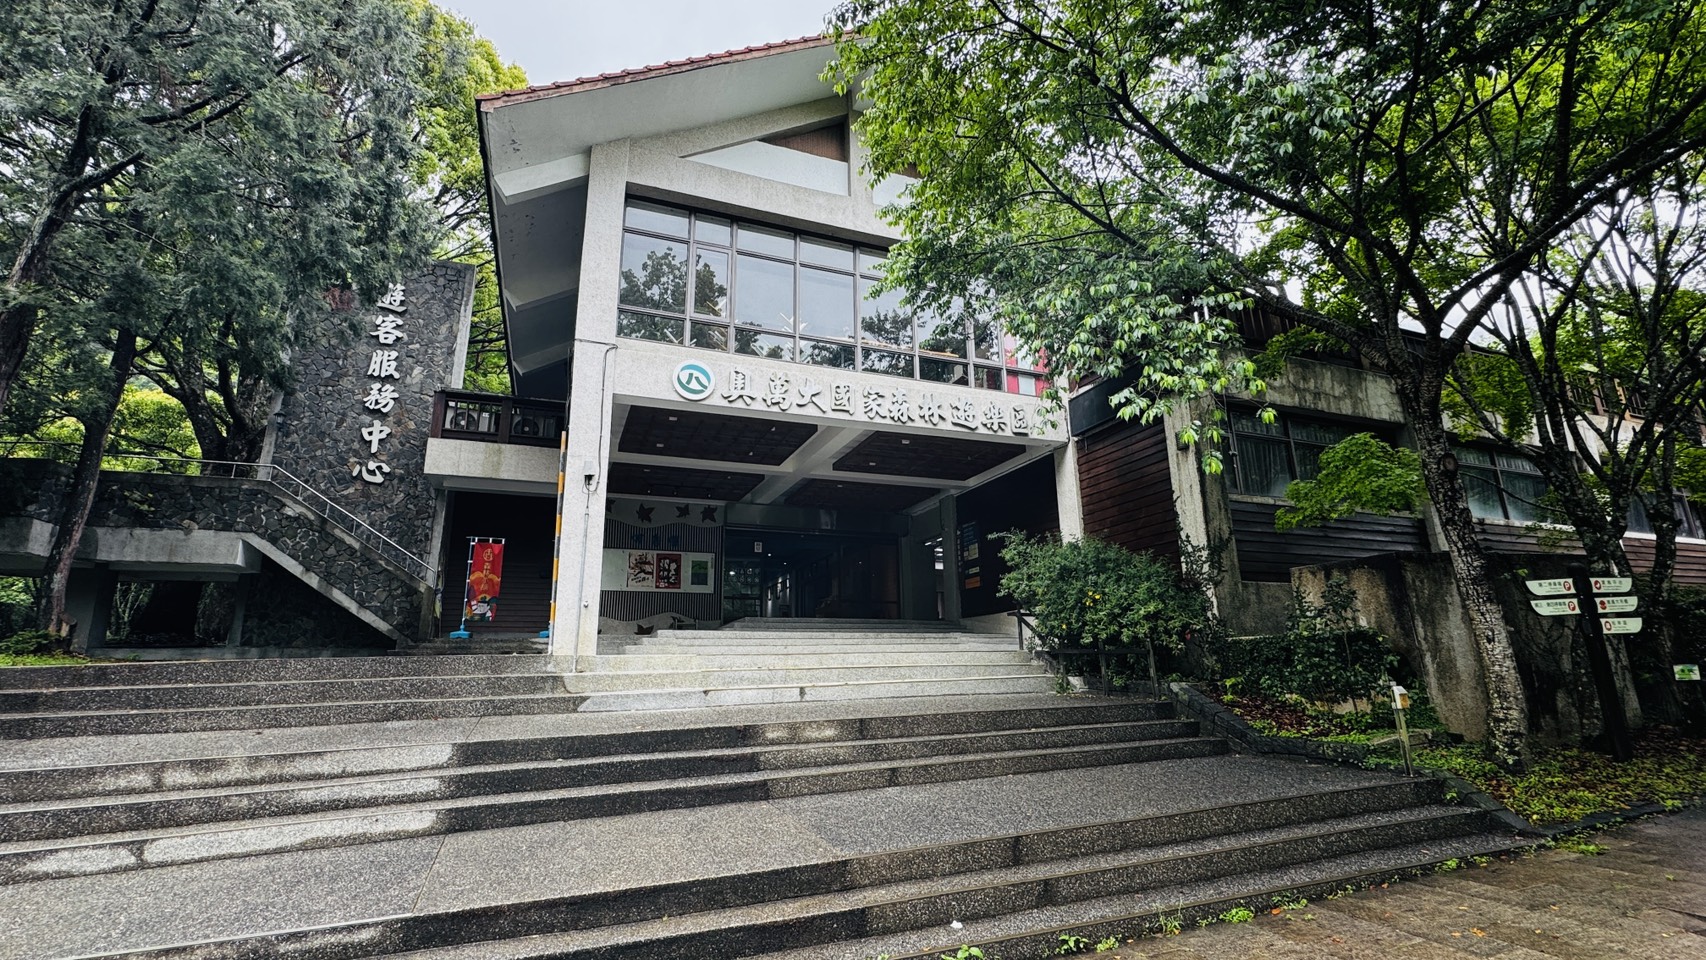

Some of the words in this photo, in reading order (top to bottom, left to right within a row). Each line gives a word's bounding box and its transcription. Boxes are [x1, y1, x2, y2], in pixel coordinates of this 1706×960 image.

[352, 282, 407, 484] 遊客服務中心
[721, 367, 1031, 435] 奧萬大國家森林遊樂區
